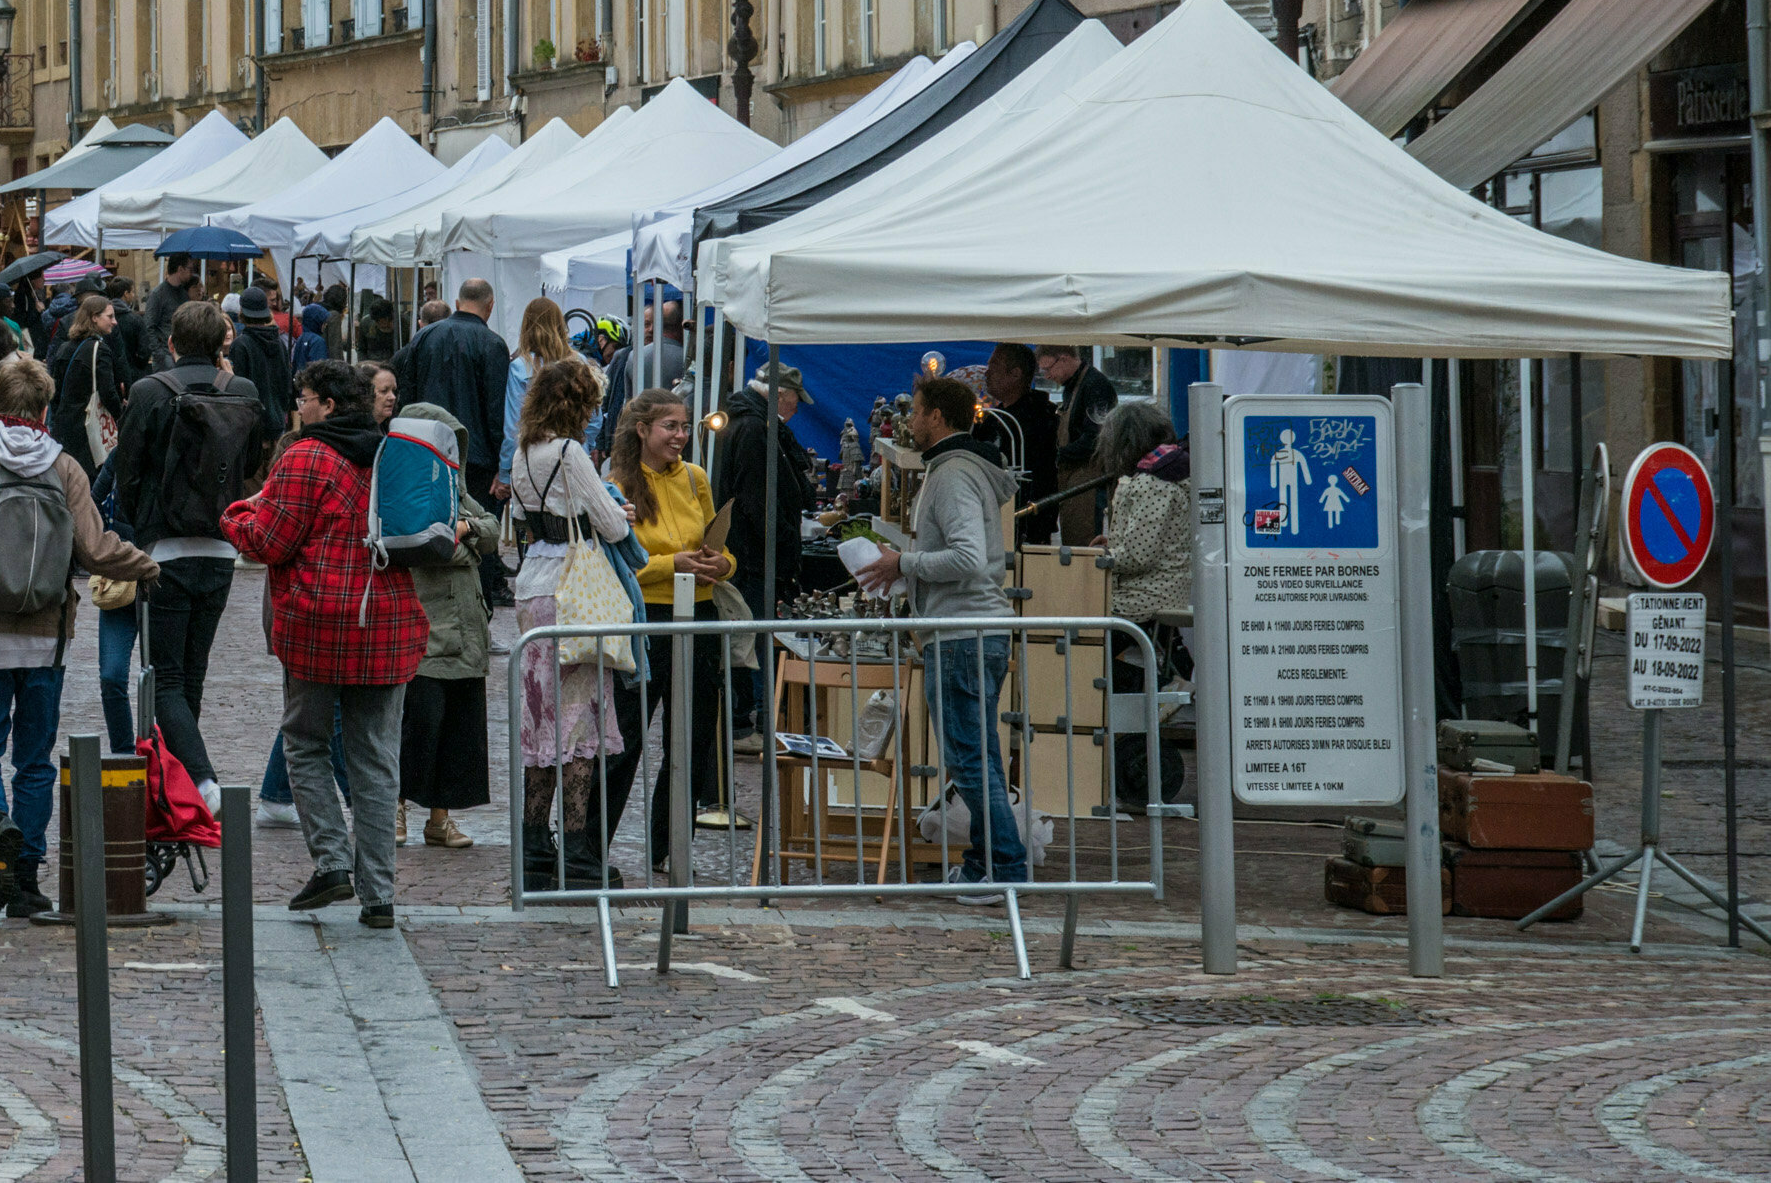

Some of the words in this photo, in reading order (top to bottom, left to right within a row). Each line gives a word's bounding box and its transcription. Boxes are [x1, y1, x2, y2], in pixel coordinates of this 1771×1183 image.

[1244, 566, 1270, 577] ZONE
[1273, 566, 1312, 577] FERMEE
[1316, 566, 1334, 577] PAR
[1338, 566, 1379, 577] BORNES
[1257, 580, 1278, 588] SOUS
[1280, 580, 1302, 588] VIDEO
[1305, 580, 1363, 588] SURVEILLANCE
[1255, 593, 1276, 602] ACCES
[1278, 593, 1308, 602] AUTORISE
[1310, 593, 1327, 602] POUR
[1329, 593, 1369, 602] LIVRAISONS:
[1241, 621, 1250, 631] DE
[1251, 621, 1264, 631] 6H00
[1267, 621, 1272, 631] A
[1275, 621, 1291, 631] 11H00
[1292, 621, 1312, 631] JOURS
[1314, 621, 1335, 631] FERIES
[1337, 621, 1364, 631] COMPRIS
[1653, 615, 1685, 629] GÊNANT
[1635, 632, 1648, 648] DU
[1654, 634, 1701, 653] 17-09-2022
[1242, 645, 1250, 655] DE
[1252, 645, 1269, 655] 19H00
[1271, 645, 1276, 655] A
[1278, 645, 1295, 655] 21H00
[1297, 645, 1316, 655] JOURS
[1318, 645, 1339, 655] FERIES
[1341, 645, 1369, 655] COMPRIS
[1278, 669, 1300, 679] ACCES
[1302, 669, 1348, 679] REGLEMENTE:
[1633, 659, 1646, 674] AU
[1652, 661, 1699, 680] 18-09-2022
[1244, 695, 1252, 706] DE
[1253, 695, 1269, 706] 11H00
[1271, 695, 1275, 706] A
[1278, 695, 1294, 706] 19H00
[1295, 695, 1314, 706] JOURS
[1316, 695, 1335, 706] FERIES
[1337, 695, 1363, 706] COMPRIS
[1683, 698, 1699, 706] ROUTE
[1244, 717, 1252, 728] DE
[1254, 717, 1270, 728] 19H00
[1272, 717, 1277, 728] A
[1279, 717, 1293, 728] 6H00
[1294, 717, 1314, 728] JOURS
[1315, 717, 1336, 728] FERIES
[1338, 717, 1365, 728] COMPRIS
[1246, 740, 1271, 750] ARRETS
[1273, 740, 1310, 750] AUTORISES
[1332, 740, 1345, 750] PAR
[1347, 740, 1371, 750] DISQUE
[1373, 740, 1391, 750] BLEU
[1246, 763, 1279, 773] LIMITEE
[1282, 763, 1289, 773] A
[1291, 763, 1306, 773] 16T
[1247, 782, 1279, 790] VITESSE
[1282, 782, 1312, 790] LIMITEE
[1315, 782, 1320, 790] A
[1322, 782, 1344, 790] 10KM
